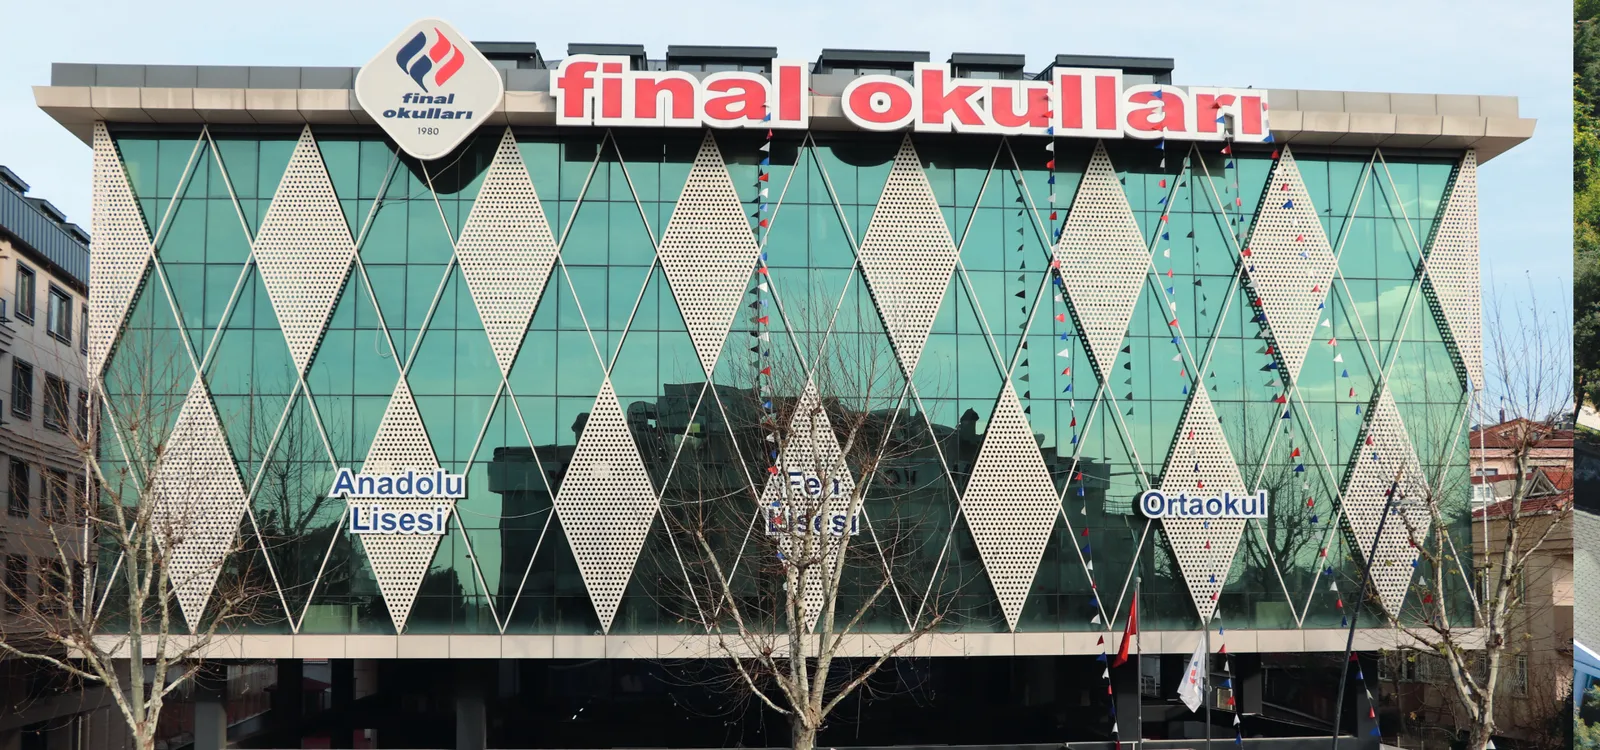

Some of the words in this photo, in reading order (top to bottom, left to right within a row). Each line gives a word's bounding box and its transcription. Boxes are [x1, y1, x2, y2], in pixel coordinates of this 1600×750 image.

[402, 93, 455, 104] final
[558, 62, 801, 120] final
[849, 70, 1262, 134] okulları
[383, 107, 473, 119] okulları
[417, 127, 439, 135] 1980
[333, 471, 462, 495] Anadolu
[1143, 491, 1265, 516] Ortaokul
[353, 507, 442, 531] Lisesi
